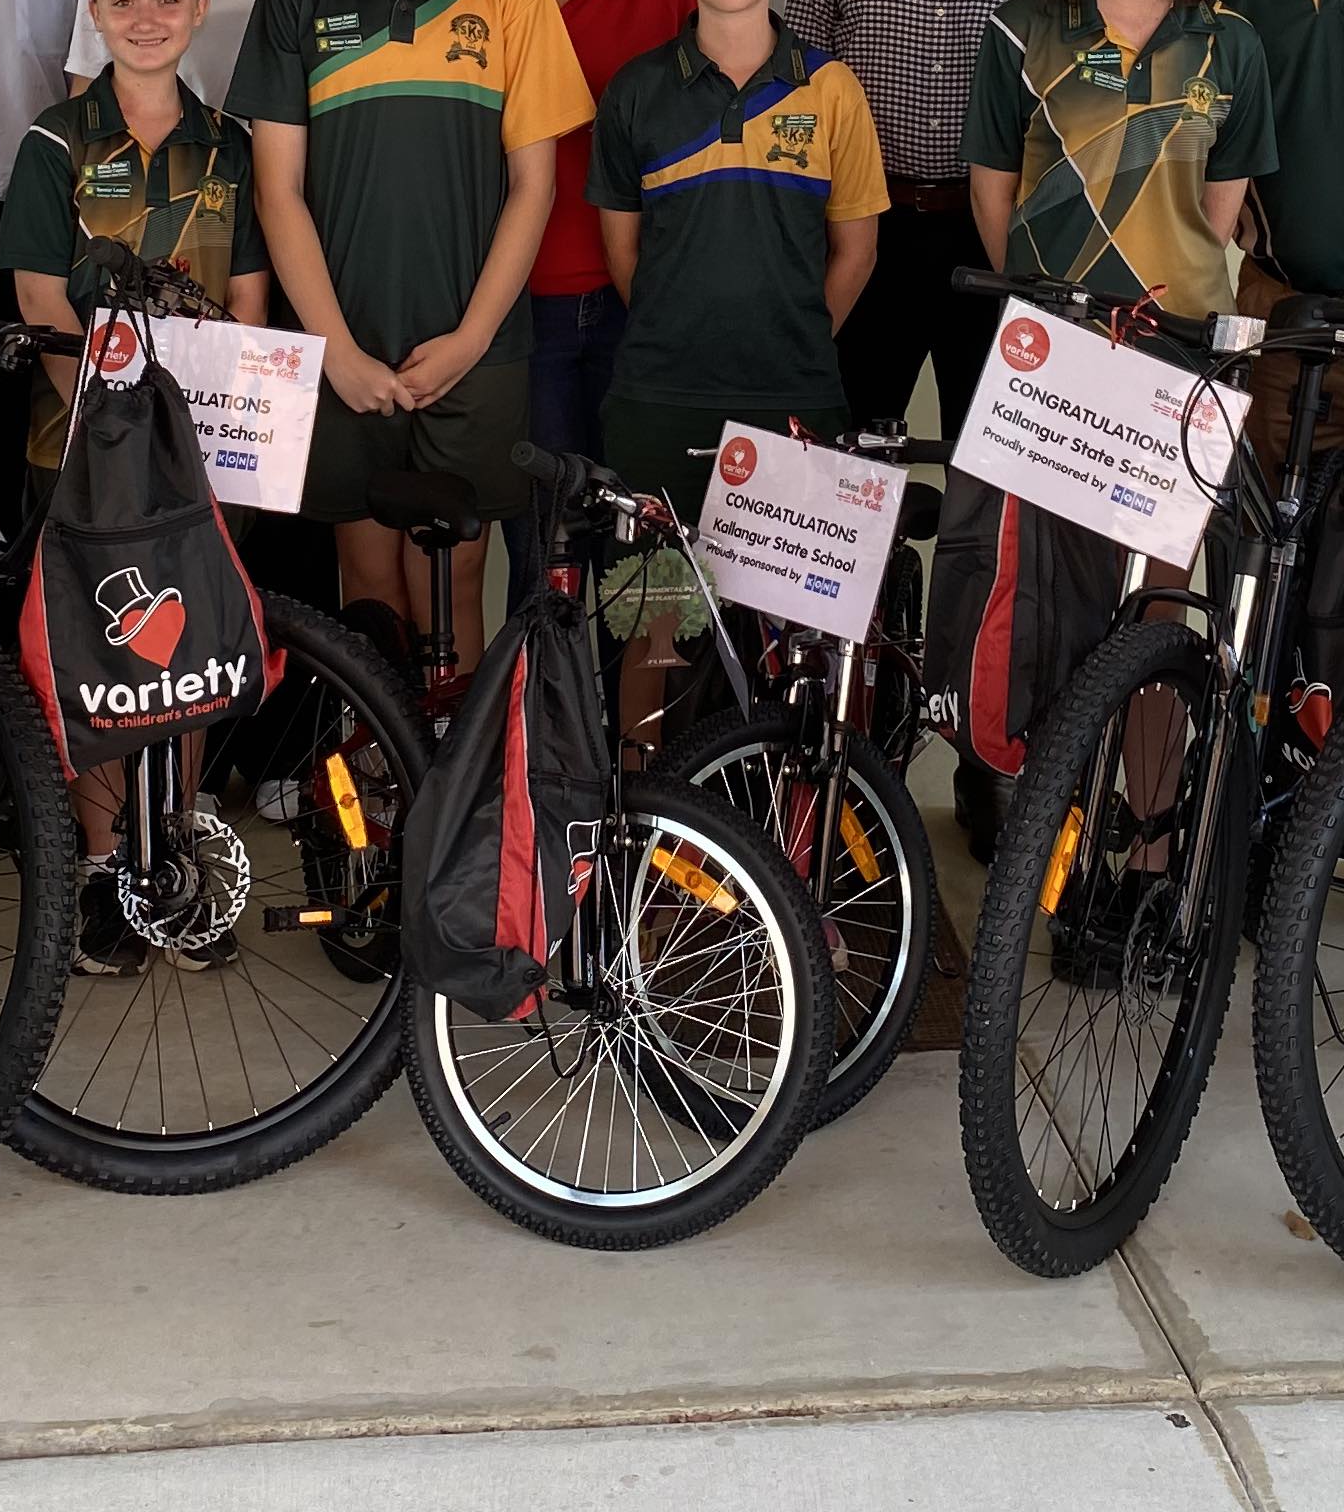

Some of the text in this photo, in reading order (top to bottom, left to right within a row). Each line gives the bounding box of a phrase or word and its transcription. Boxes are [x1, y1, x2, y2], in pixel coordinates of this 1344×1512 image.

[241, 350, 268, 363] Bikes
[1005, 343, 1040, 366] variety
[259, 366, 299, 380] for Kids
[1155, 388, 1183, 408] Bikes
[1008, 377, 1179, 462] CONGRATULATIONS
[219, 424, 274, 444] School
[992, 400, 1177, 493] Kallangur State School
[216, 449, 258, 471] KONE
[723, 463, 750, 478] variety
[983, 426, 1157, 516] Proudly sponsored by KONE
[839, 478, 859, 493] Bikes
[851, 496, 882, 512] for Kids
[726, 492, 858, 544] CONGRATULATIONS
[713, 517, 856, 573] Kallangur State School
[706, 544, 840, 598] Proudly sponsored by KONE
[79, 655, 246, 713] variety
[90, 716, 113, 728] the
[186, 696, 231, 717] charity
